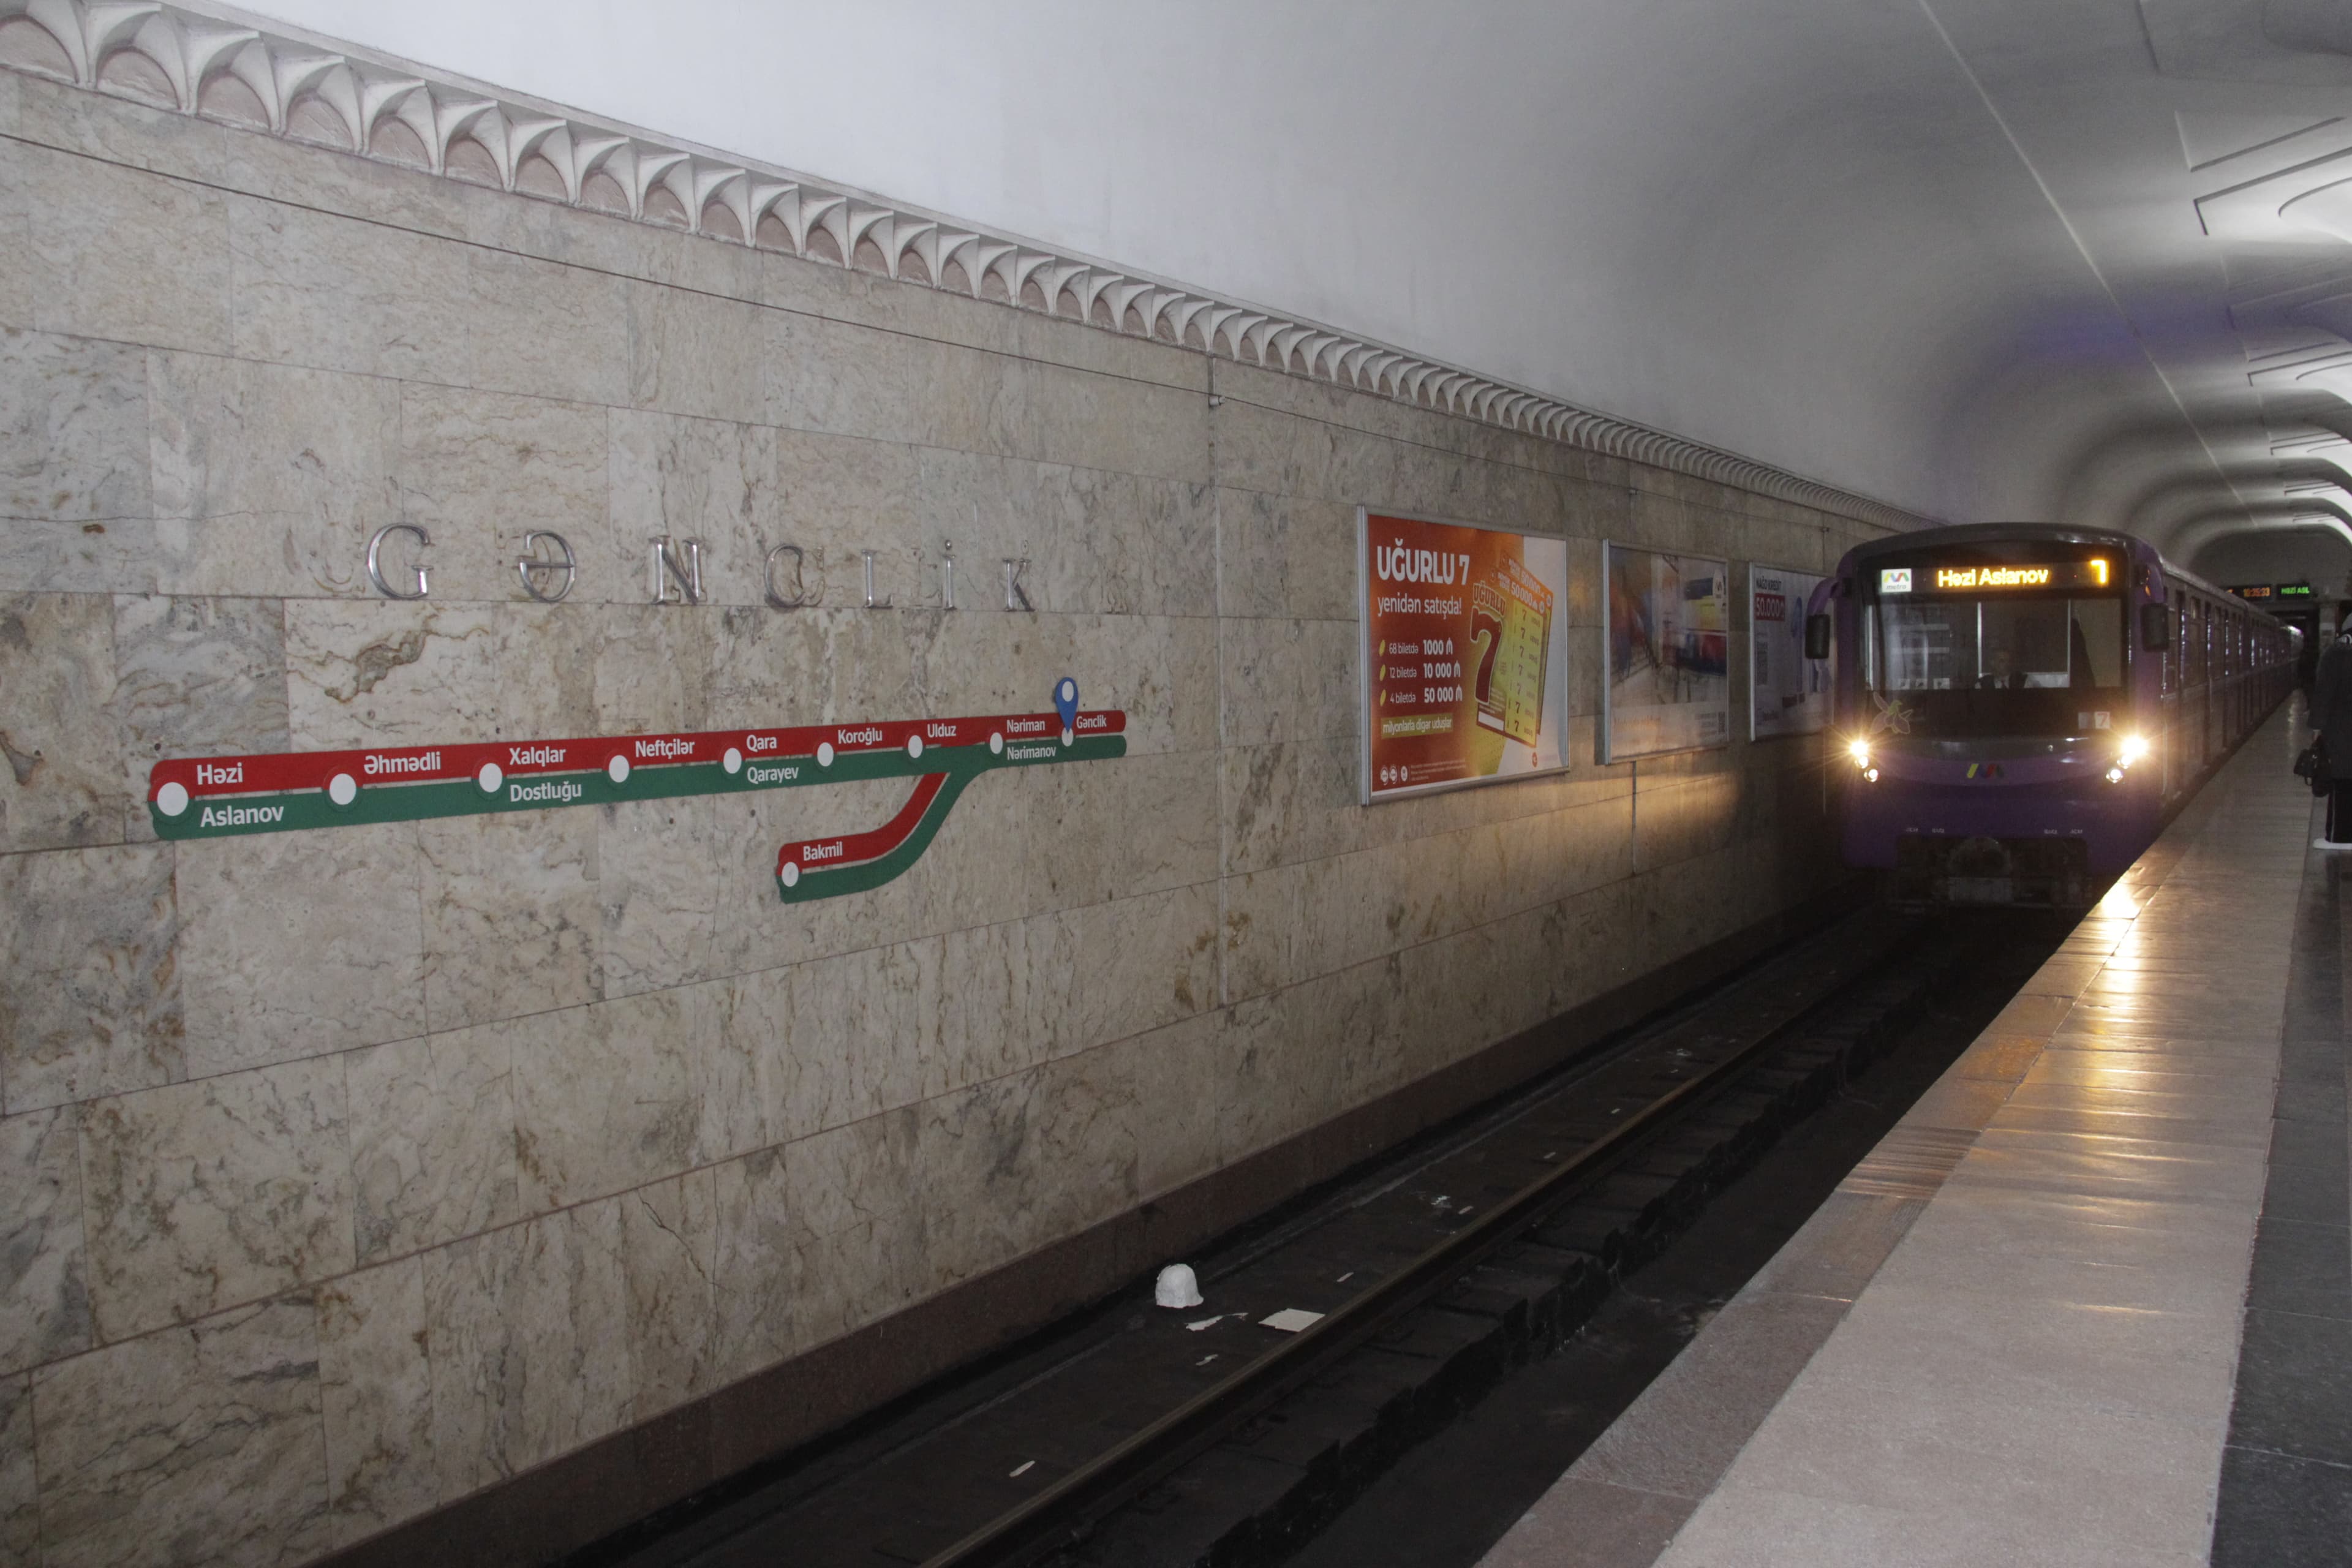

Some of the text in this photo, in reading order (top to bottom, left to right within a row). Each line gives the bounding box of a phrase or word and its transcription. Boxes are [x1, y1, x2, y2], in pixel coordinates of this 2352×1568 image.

[1377, 538, 1455, 584] UĞURLU
[1459, 554, 1469, 585] 7
[1378, 588, 1421, 617] yenidən
[1473, 581, 1506, 617] UĞURLU
[1389, 643, 1396, 654] 68
[1423, 639, 1444, 655] 1000
[1471, 605, 1503, 705] 7
[1423, 663, 1433, 679] 10
[1435, 662, 1452, 678] 000
[1390, 693, 1395, 703] 4
[1424, 687, 1435, 703] 50
[1437, 687, 1453, 702] 000
[927, 723, 956, 737] Ulduz
[1006, 719, 1046, 733] Nəriman
[1076, 715, 1107, 729] Gənclik
[746, 734, 777, 751] Qara
[837, 727, 883, 745] Koroğlu
[509, 746, 566, 768] Xalqlar
[635, 740, 695, 760] Neftçilər
[1006, 746, 1057, 760] Nərimanov
[364, 752, 442, 775] Əhmədli
[196, 762, 243, 785] Həzi
[747, 766, 799, 785] Qarayev
[510, 780, 582, 803] Dostluğu
[200, 805, 284, 827] Aslanov
[803, 842, 843, 861] Bakmil
